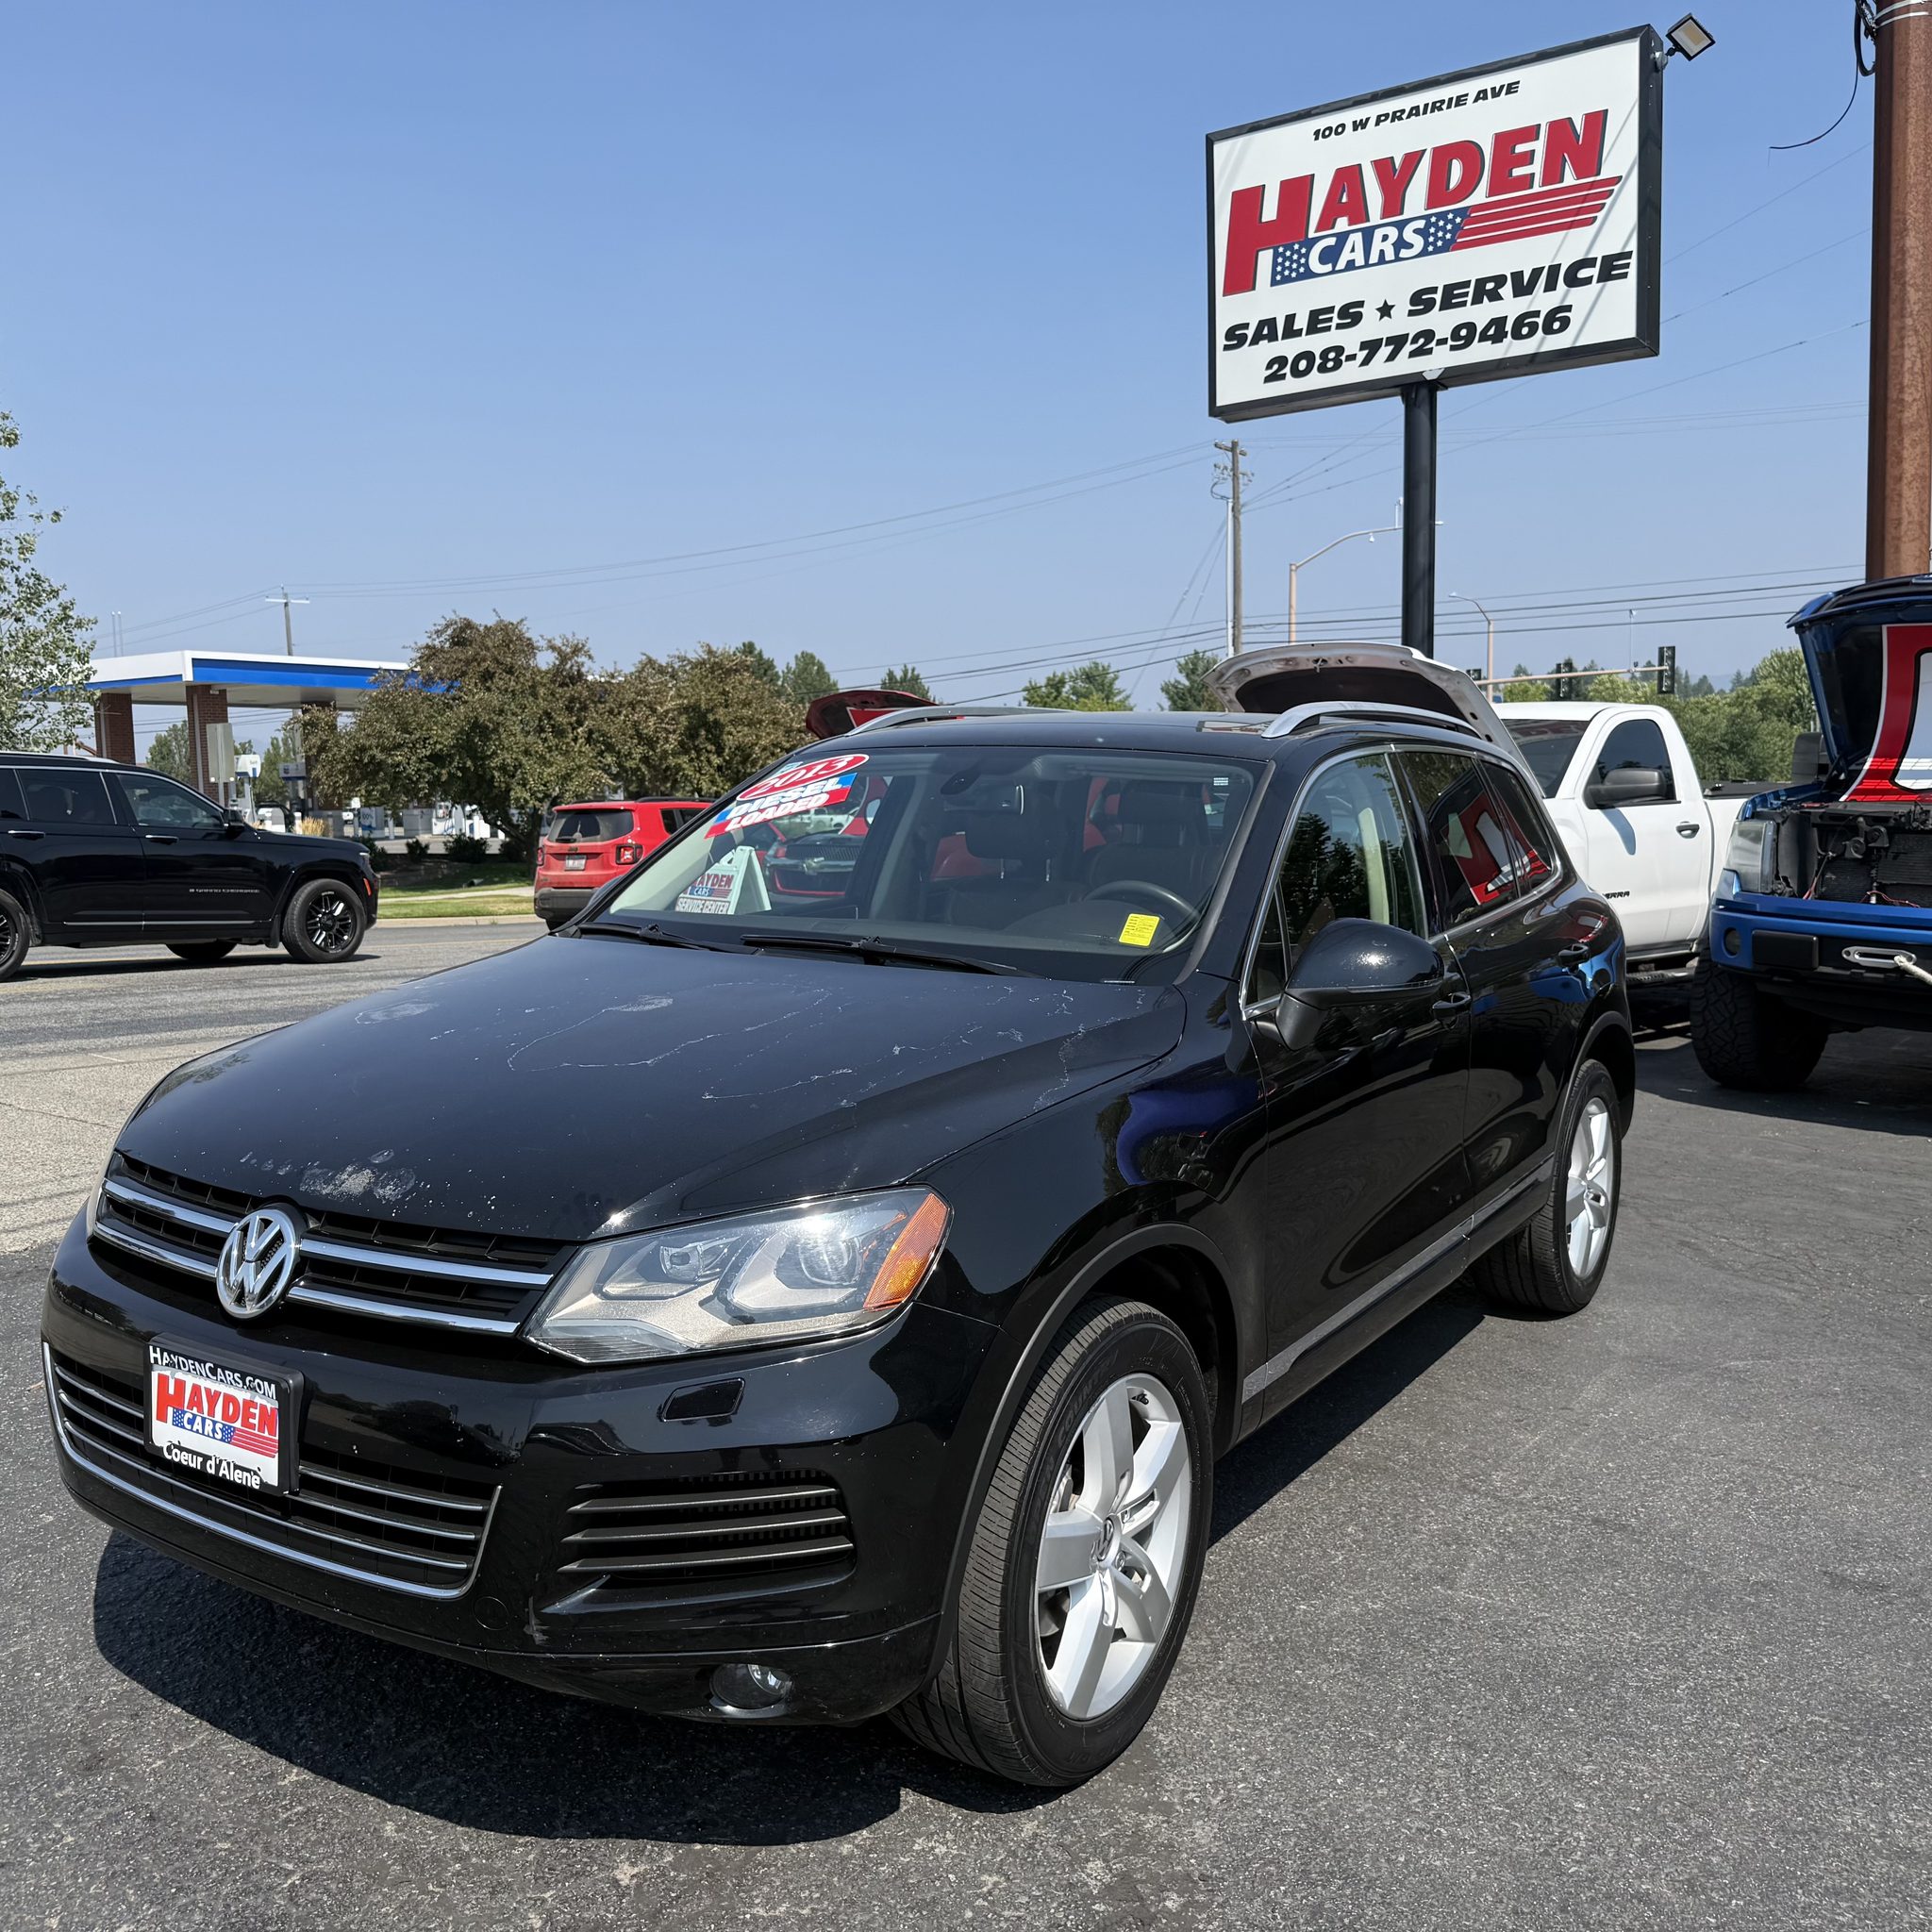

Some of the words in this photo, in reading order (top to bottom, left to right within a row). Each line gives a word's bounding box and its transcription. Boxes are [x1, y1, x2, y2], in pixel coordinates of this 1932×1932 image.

[1313, 124, 1346, 142] 100
[1352, 117, 1371, 132] W
[1374, 92, 1470, 127] PRAIRIE
[1473, 80, 1521, 104] AVE
[1223, 108, 1608, 297] HAYDEN
[1307, 218, 1431, 275] CARS
[1223, 300, 1364, 352] SALES
[1407, 251, 1633, 317] SERVICE
[1262, 305, 1573, 384] 208-772-9466
[725, 775, 842, 820] DIESEL
[744, 756, 855, 799] 2013
[724, 791, 830, 831] LOADED
[693, 886, 710, 896] CARS
[705, 901, 729, 914] CENTER
[156, 1373, 278, 1437] HAYDEN
[183, 1411, 224, 1441] CARS
[163, 1441, 204, 1470] Coeur
[207, 1456, 260, 1490] d'Alene
